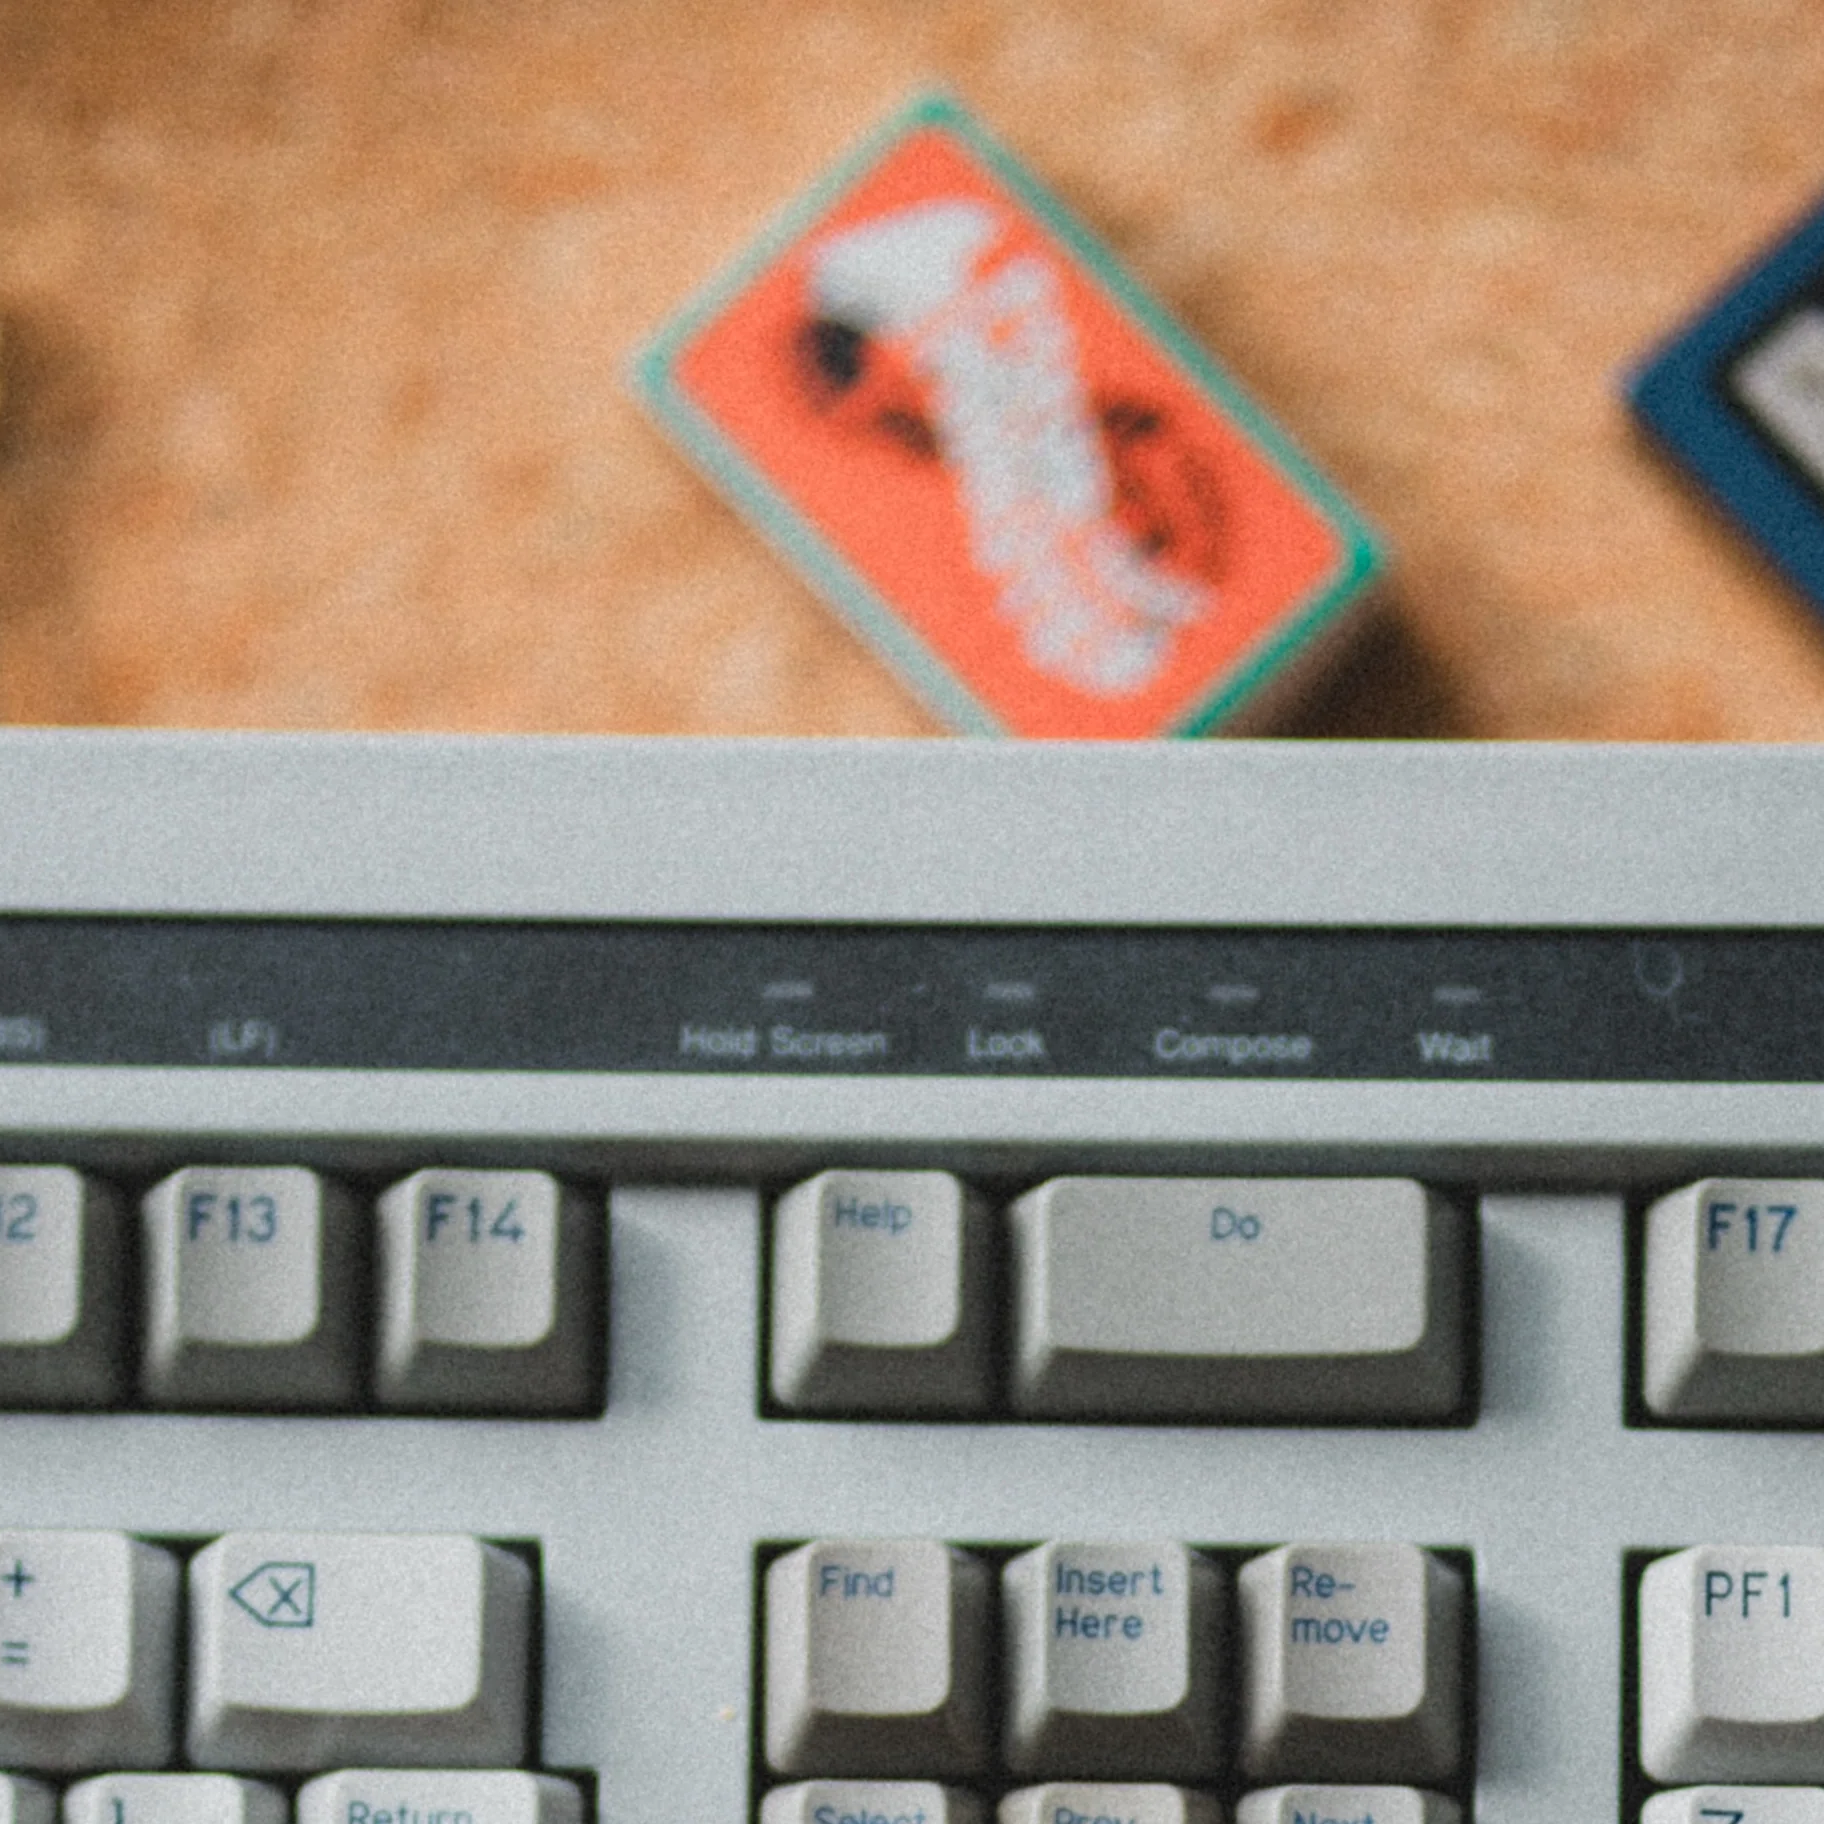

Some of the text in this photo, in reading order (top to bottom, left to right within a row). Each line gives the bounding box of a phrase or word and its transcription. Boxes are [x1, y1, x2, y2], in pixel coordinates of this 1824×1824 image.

[1152, 1026, 1314, 1066] Compose
[184, 1190, 276, 1245] F13
[422, 1190, 523, 1247] F14
[832, 1194, 914, 1237] Help
[1208, 1204, 1264, 1244] Do
[1703, 1198, 1798, 1254] F17
[1, 1561, 34, 1598] +
[815, 1561, 895, 1600] Find
[1050, 1558, 1163, 1599] Insert
[1288, 1561, 1354, 1602] Re-
[1702, 1568, 1791, 1620] PF1
[1052, 1604, 1143, 1641] Here
[1287, 1614, 1390, 1646] move
[0, 1639, 30, 1668] =
